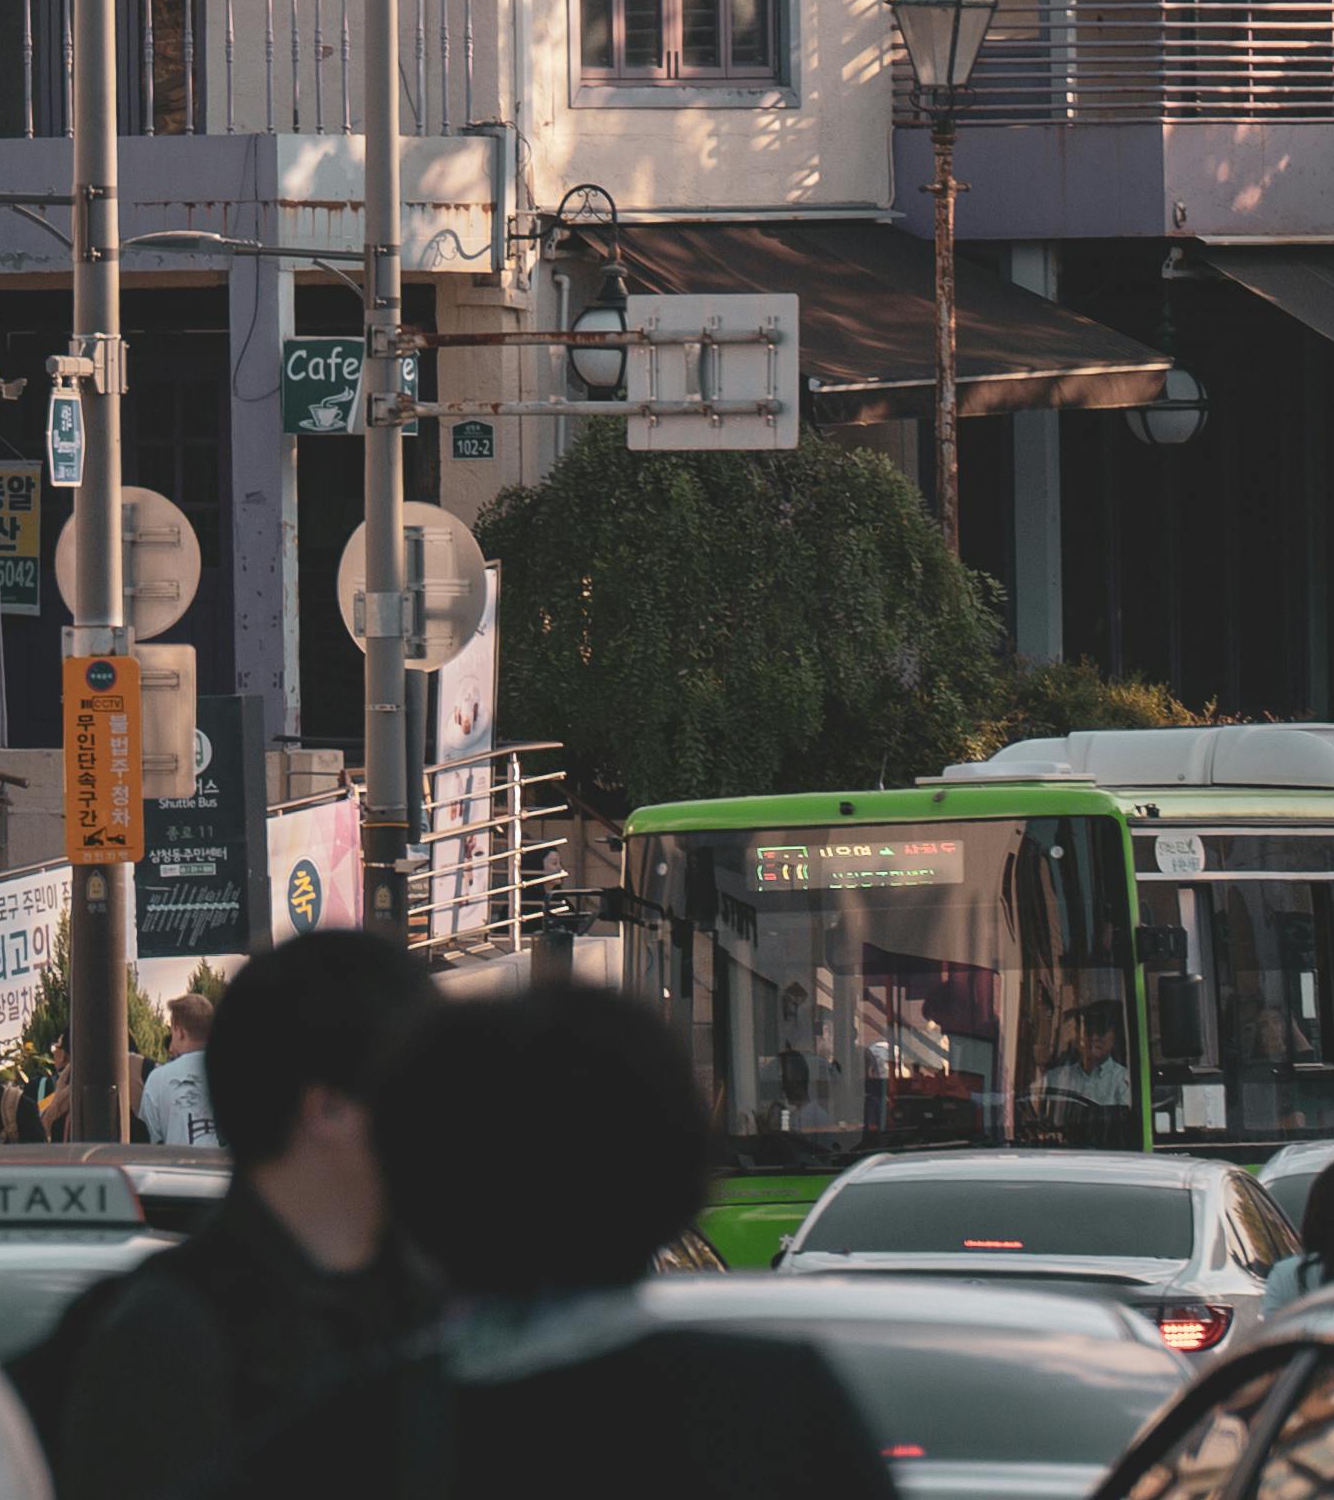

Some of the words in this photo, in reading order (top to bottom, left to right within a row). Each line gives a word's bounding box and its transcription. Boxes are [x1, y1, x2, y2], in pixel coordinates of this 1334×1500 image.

[286, 347, 360, 382] Cafe
[457, 439, 490, 455] 102-2
[94, 700, 121, 709] CCTV
[76, 714, 98, 828] 무인단속구간
[158, 797, 196, 809] Shuttle
[198, 797, 218, 809] Bus
[166, 825, 194, 841] 종로
[22, 884, 58, 916] 주민이
[291, 870, 316, 923] 축
